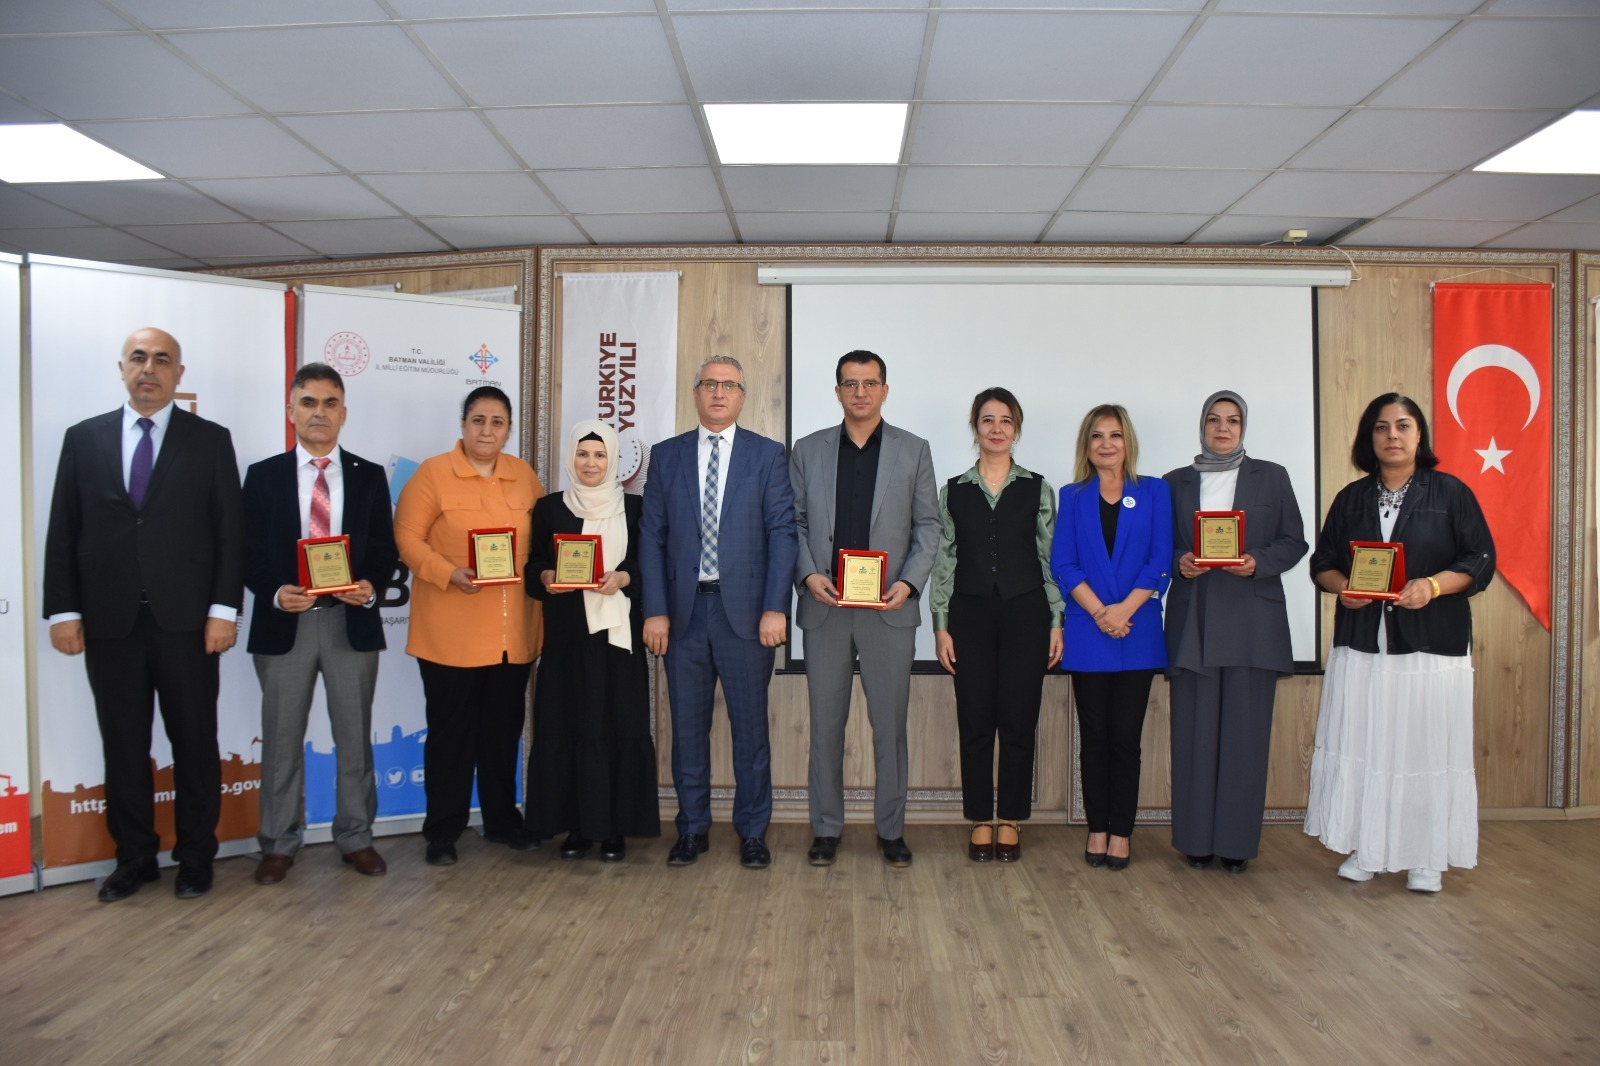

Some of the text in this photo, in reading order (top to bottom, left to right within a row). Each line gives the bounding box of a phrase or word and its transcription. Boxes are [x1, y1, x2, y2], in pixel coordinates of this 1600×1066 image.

[388, 356, 417, 364] BATMAN
[465, 378, 502, 387] BATMAN
[618, 342, 636, 433] YÜZYILI
